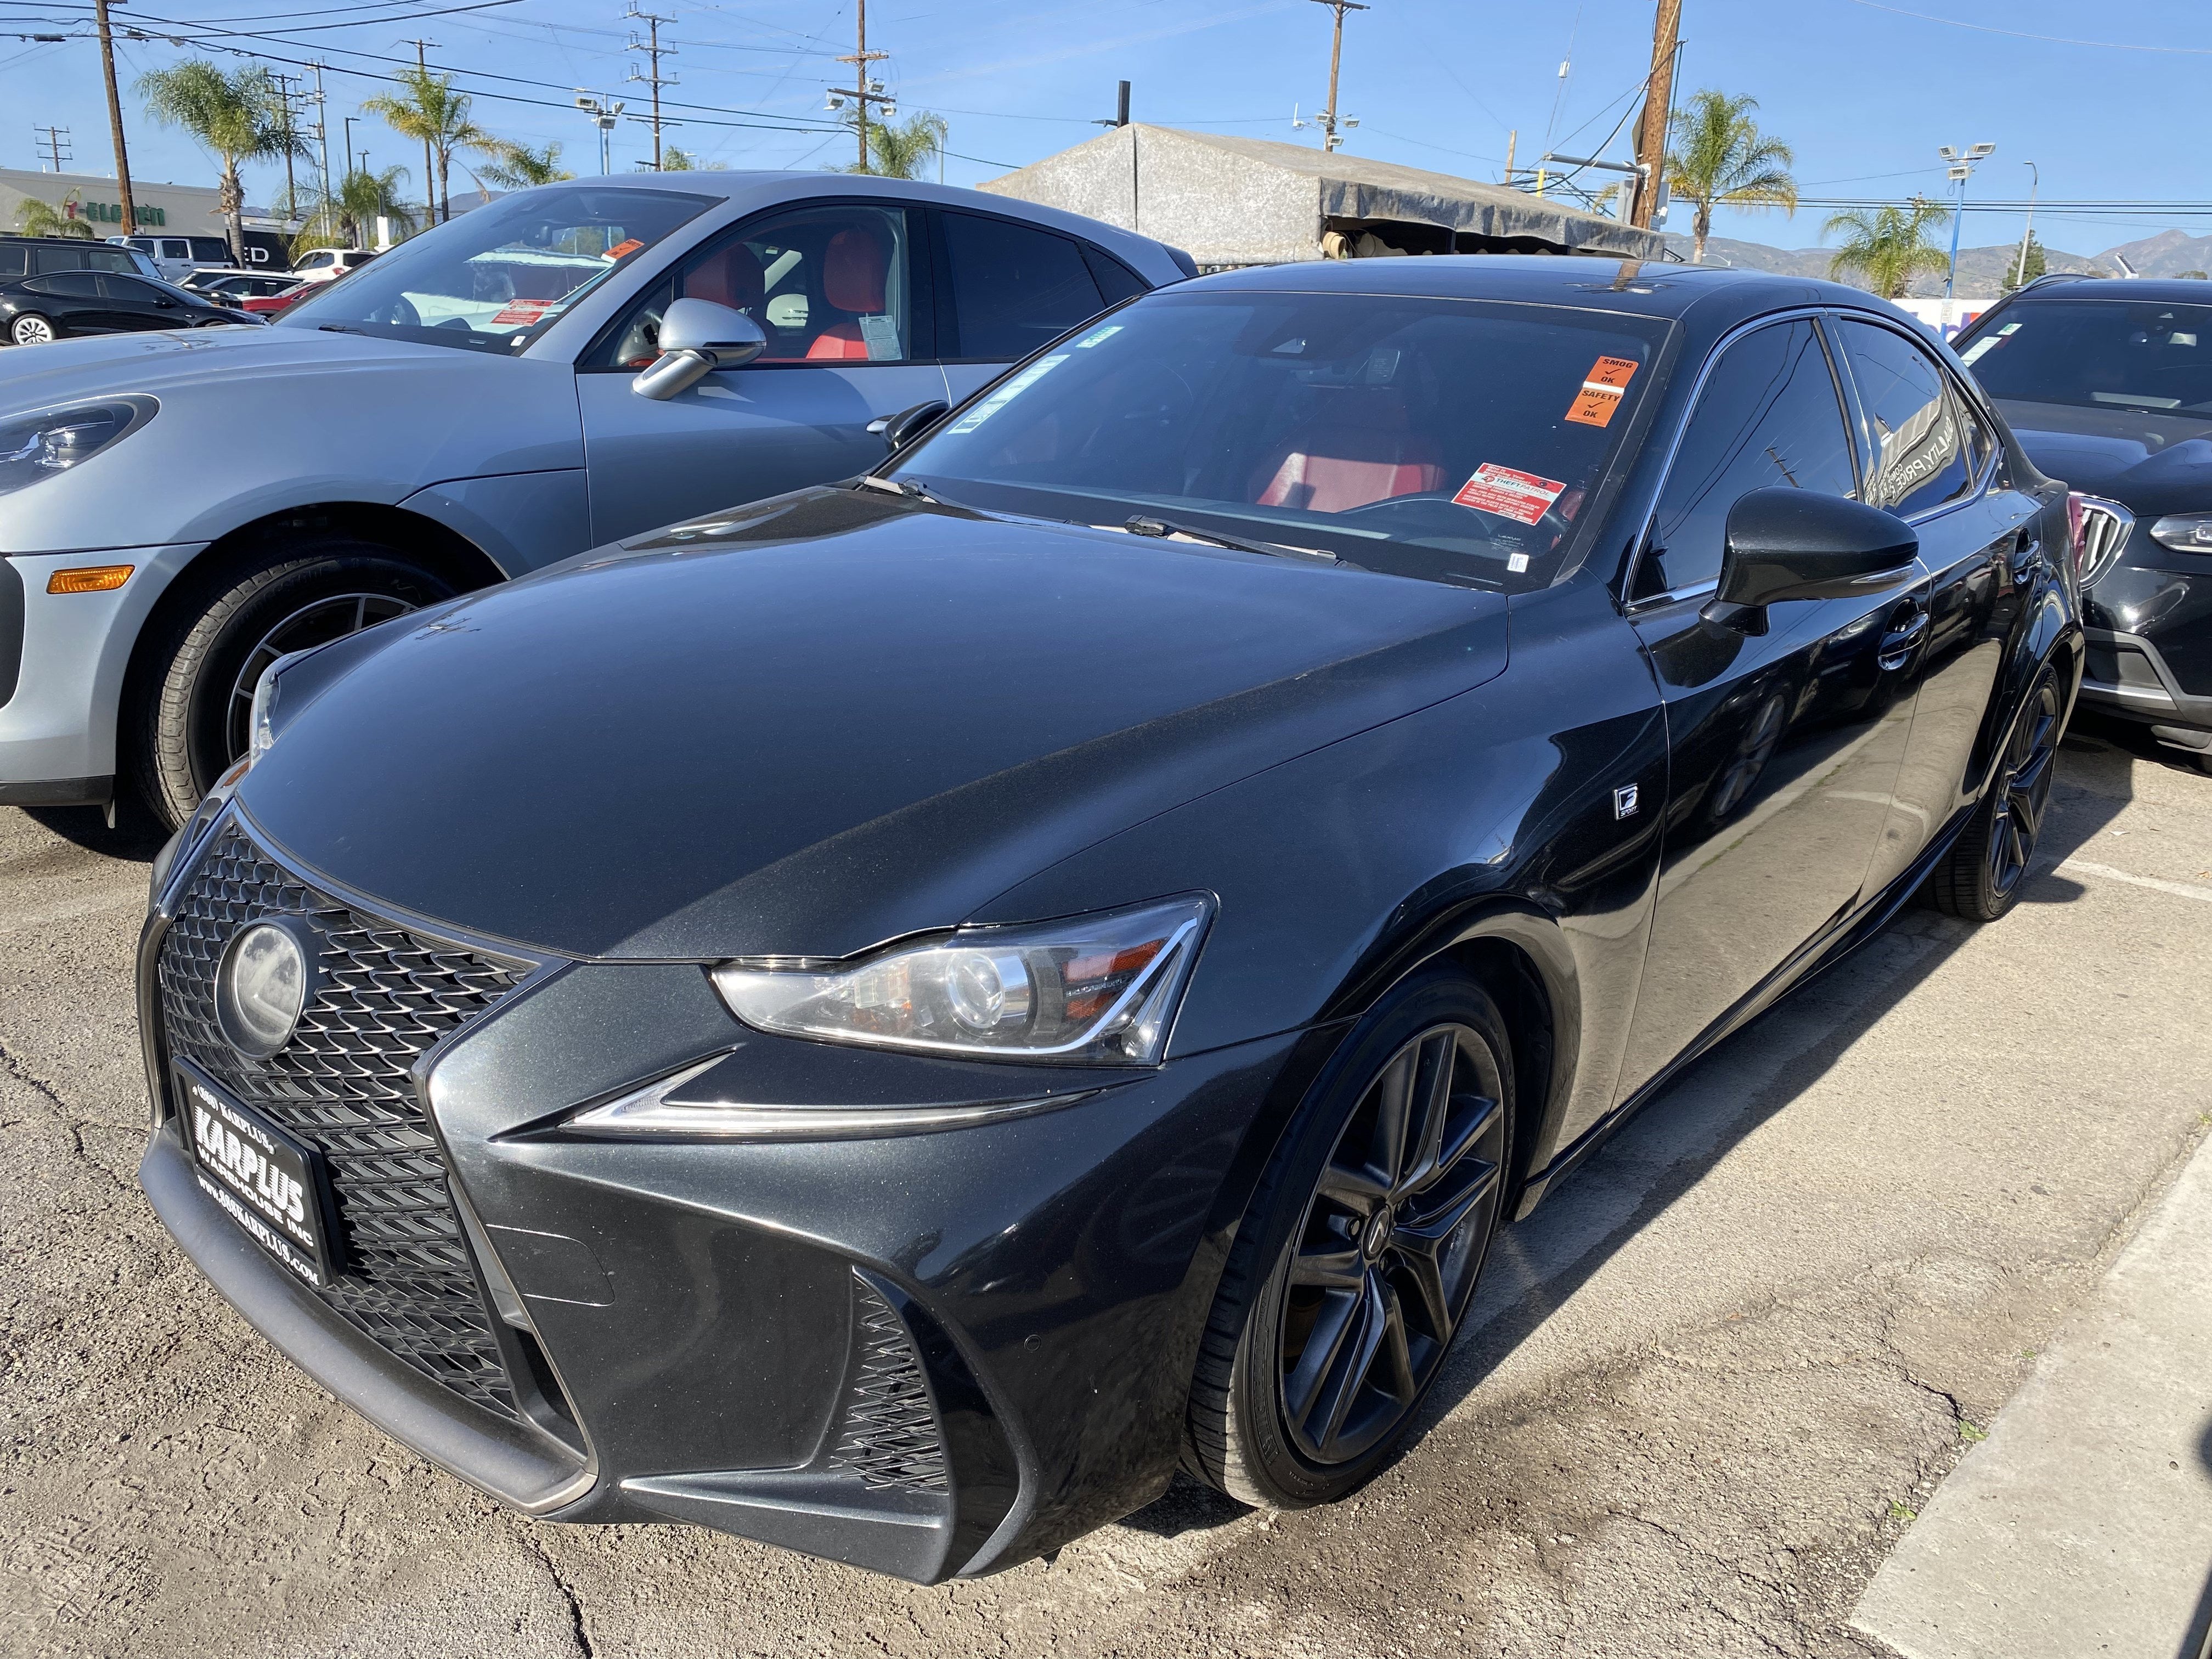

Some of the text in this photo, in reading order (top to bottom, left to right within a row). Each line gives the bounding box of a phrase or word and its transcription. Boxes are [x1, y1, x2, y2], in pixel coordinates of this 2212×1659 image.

[1602, 359, 1633, 368] SMOG
[1582, 390, 1620, 402] SAFETY
[1583, 410, 1598, 418] OK
[1621, 805, 1638, 816] SPORT
[195, 1105, 304, 1222] KARPLUS
[197, 1144, 314, 1247] WAREHOUSE INC
